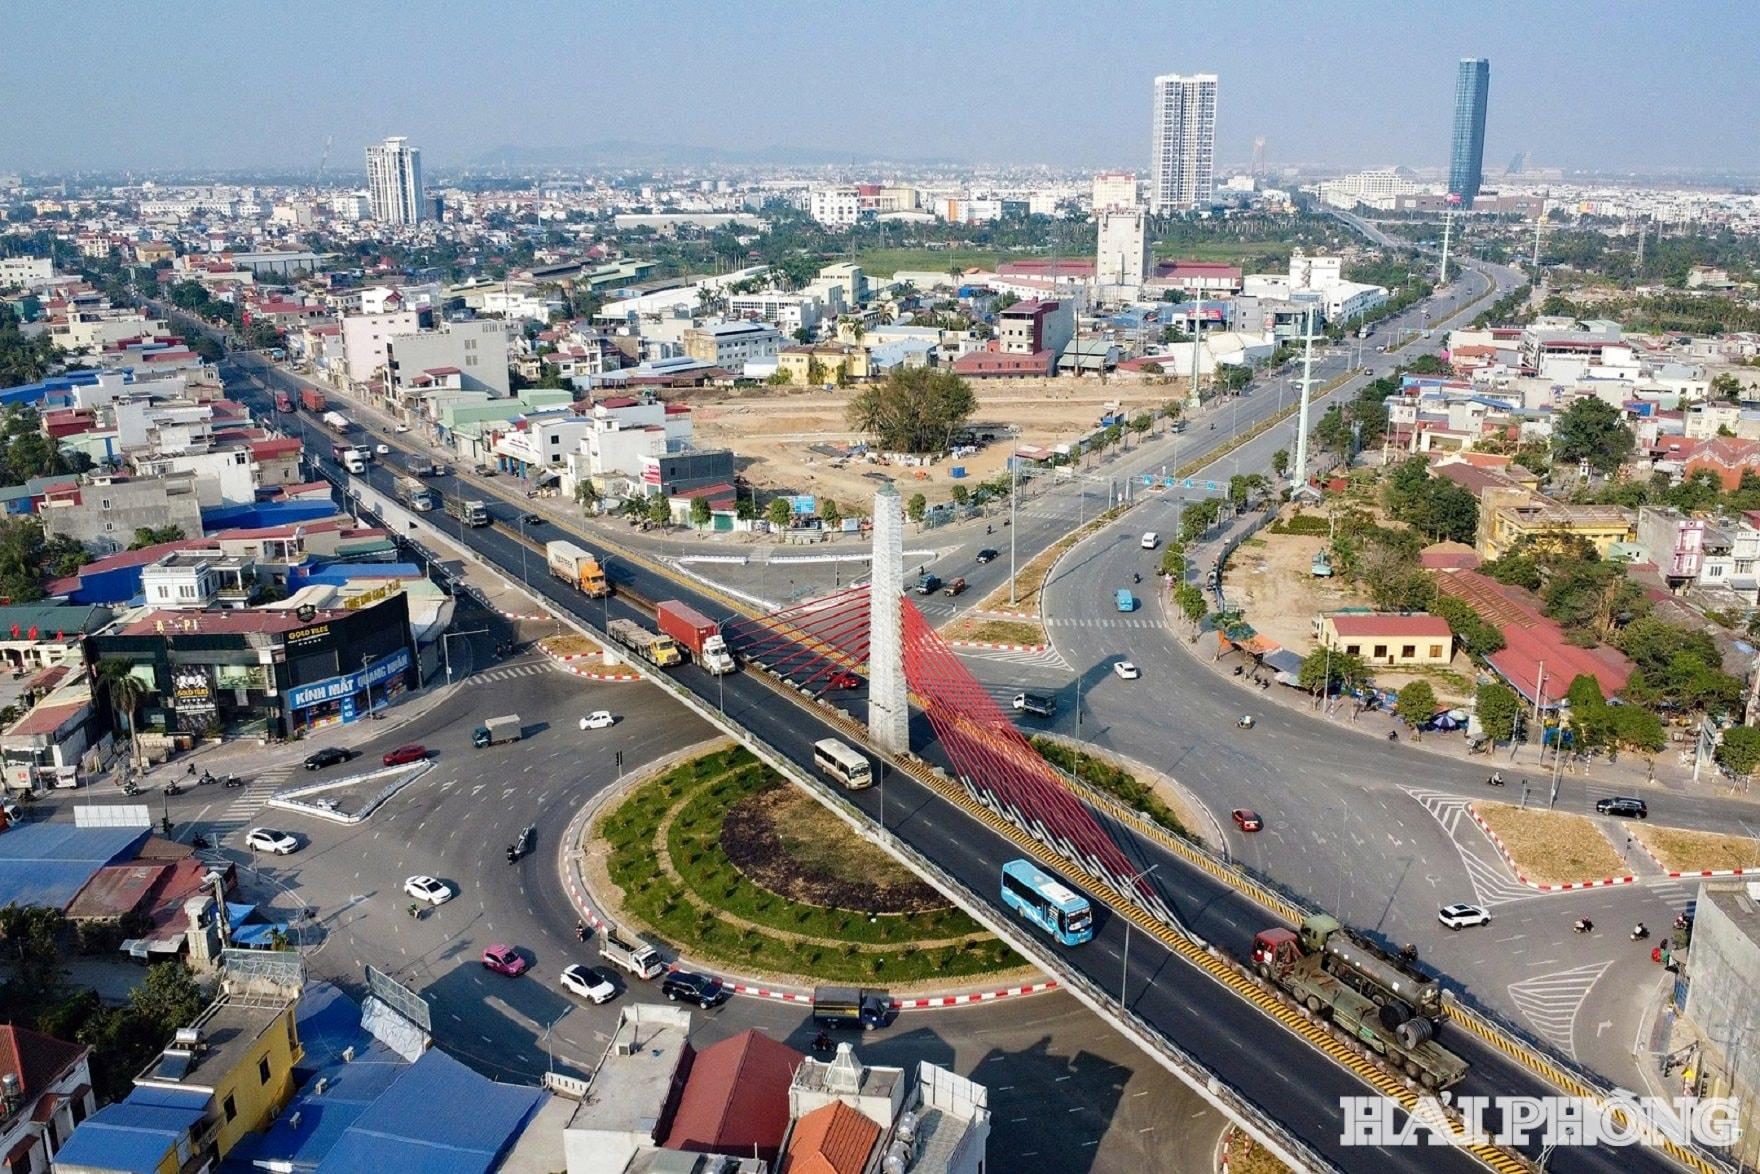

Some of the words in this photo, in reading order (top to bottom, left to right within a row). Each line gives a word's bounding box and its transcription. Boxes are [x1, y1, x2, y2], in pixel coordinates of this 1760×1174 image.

[288, 629, 310, 640] GOLD
[310, 624, 329, 634] TILES
[295, 686, 326, 705] KÍNH
[328, 676, 354, 697] MẮT
